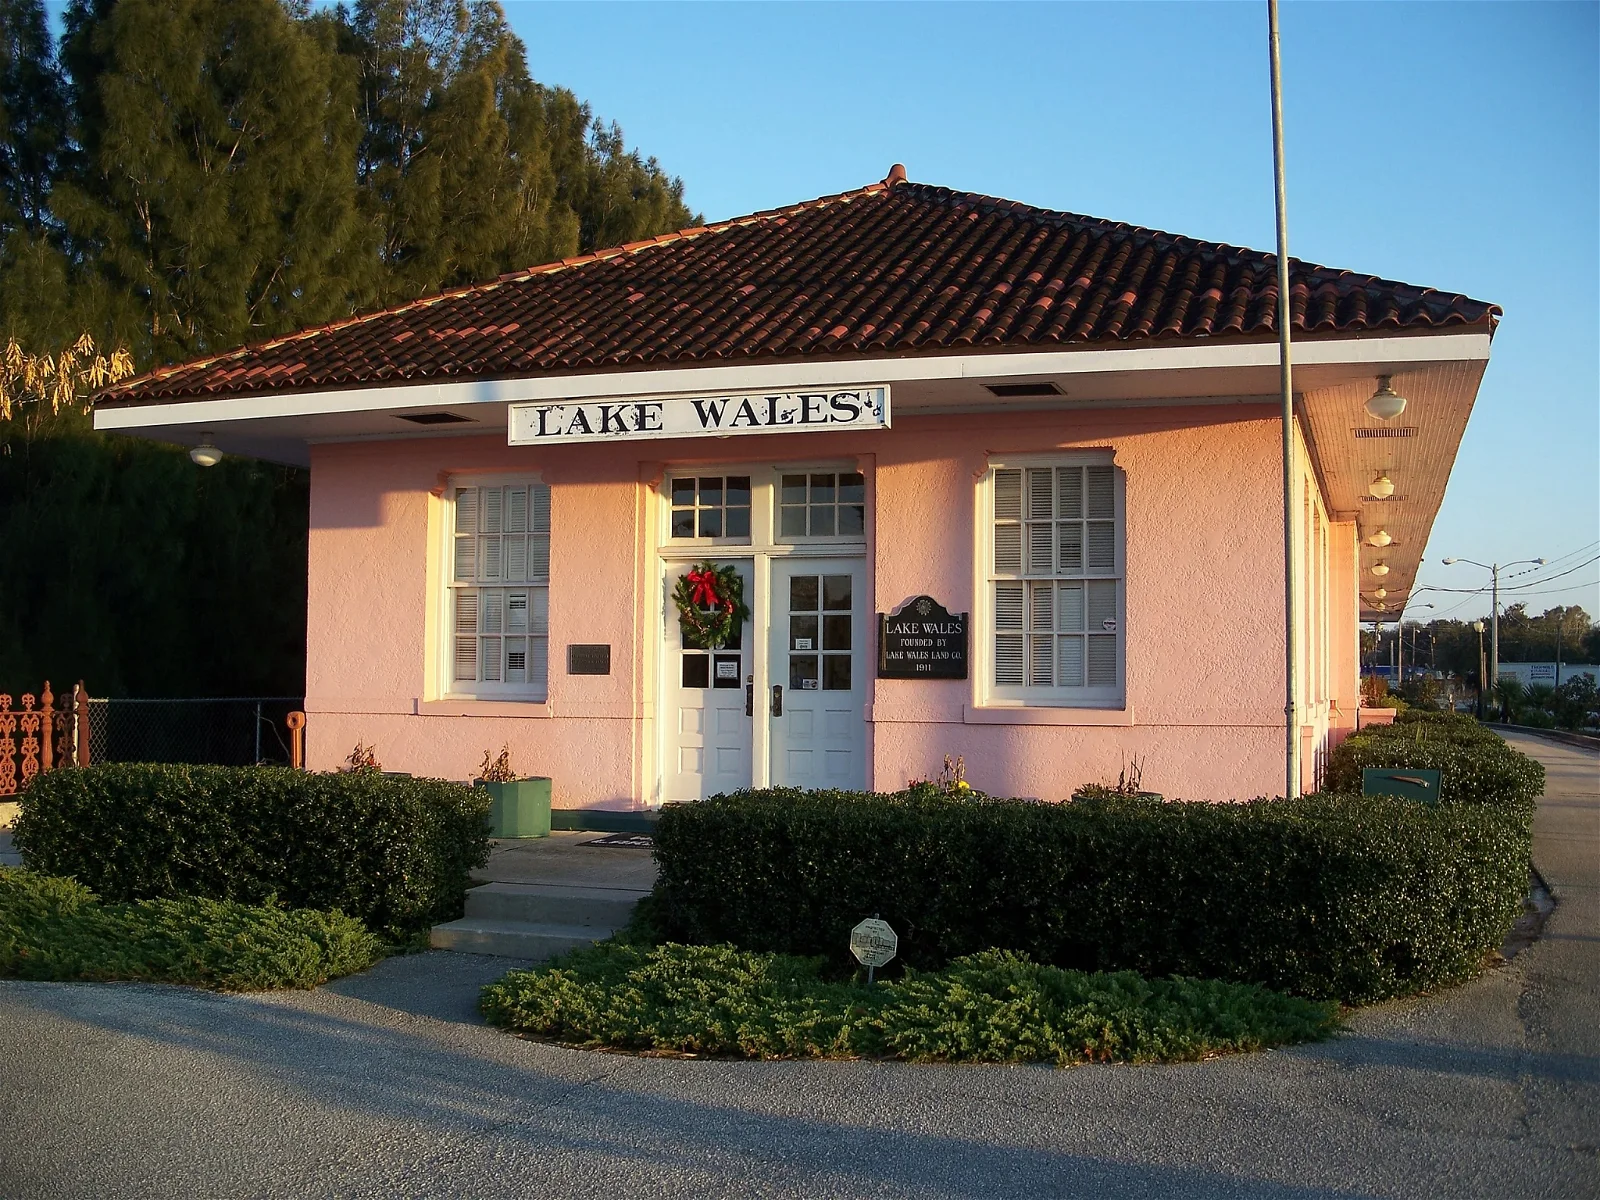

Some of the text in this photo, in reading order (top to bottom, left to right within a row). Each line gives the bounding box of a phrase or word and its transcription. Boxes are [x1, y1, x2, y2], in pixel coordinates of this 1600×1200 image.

[534, 392, 861, 437] LAKE WALES
[886, 623, 962, 634] LAKE WALES
[900, 638, 946, 647] FOUNDED BY
[886, 651, 904, 660] LAKE
[906, 651, 929, 660] WALES
[931, 651, 949, 660] LAND
[916, 664, 931, 672] 1911
